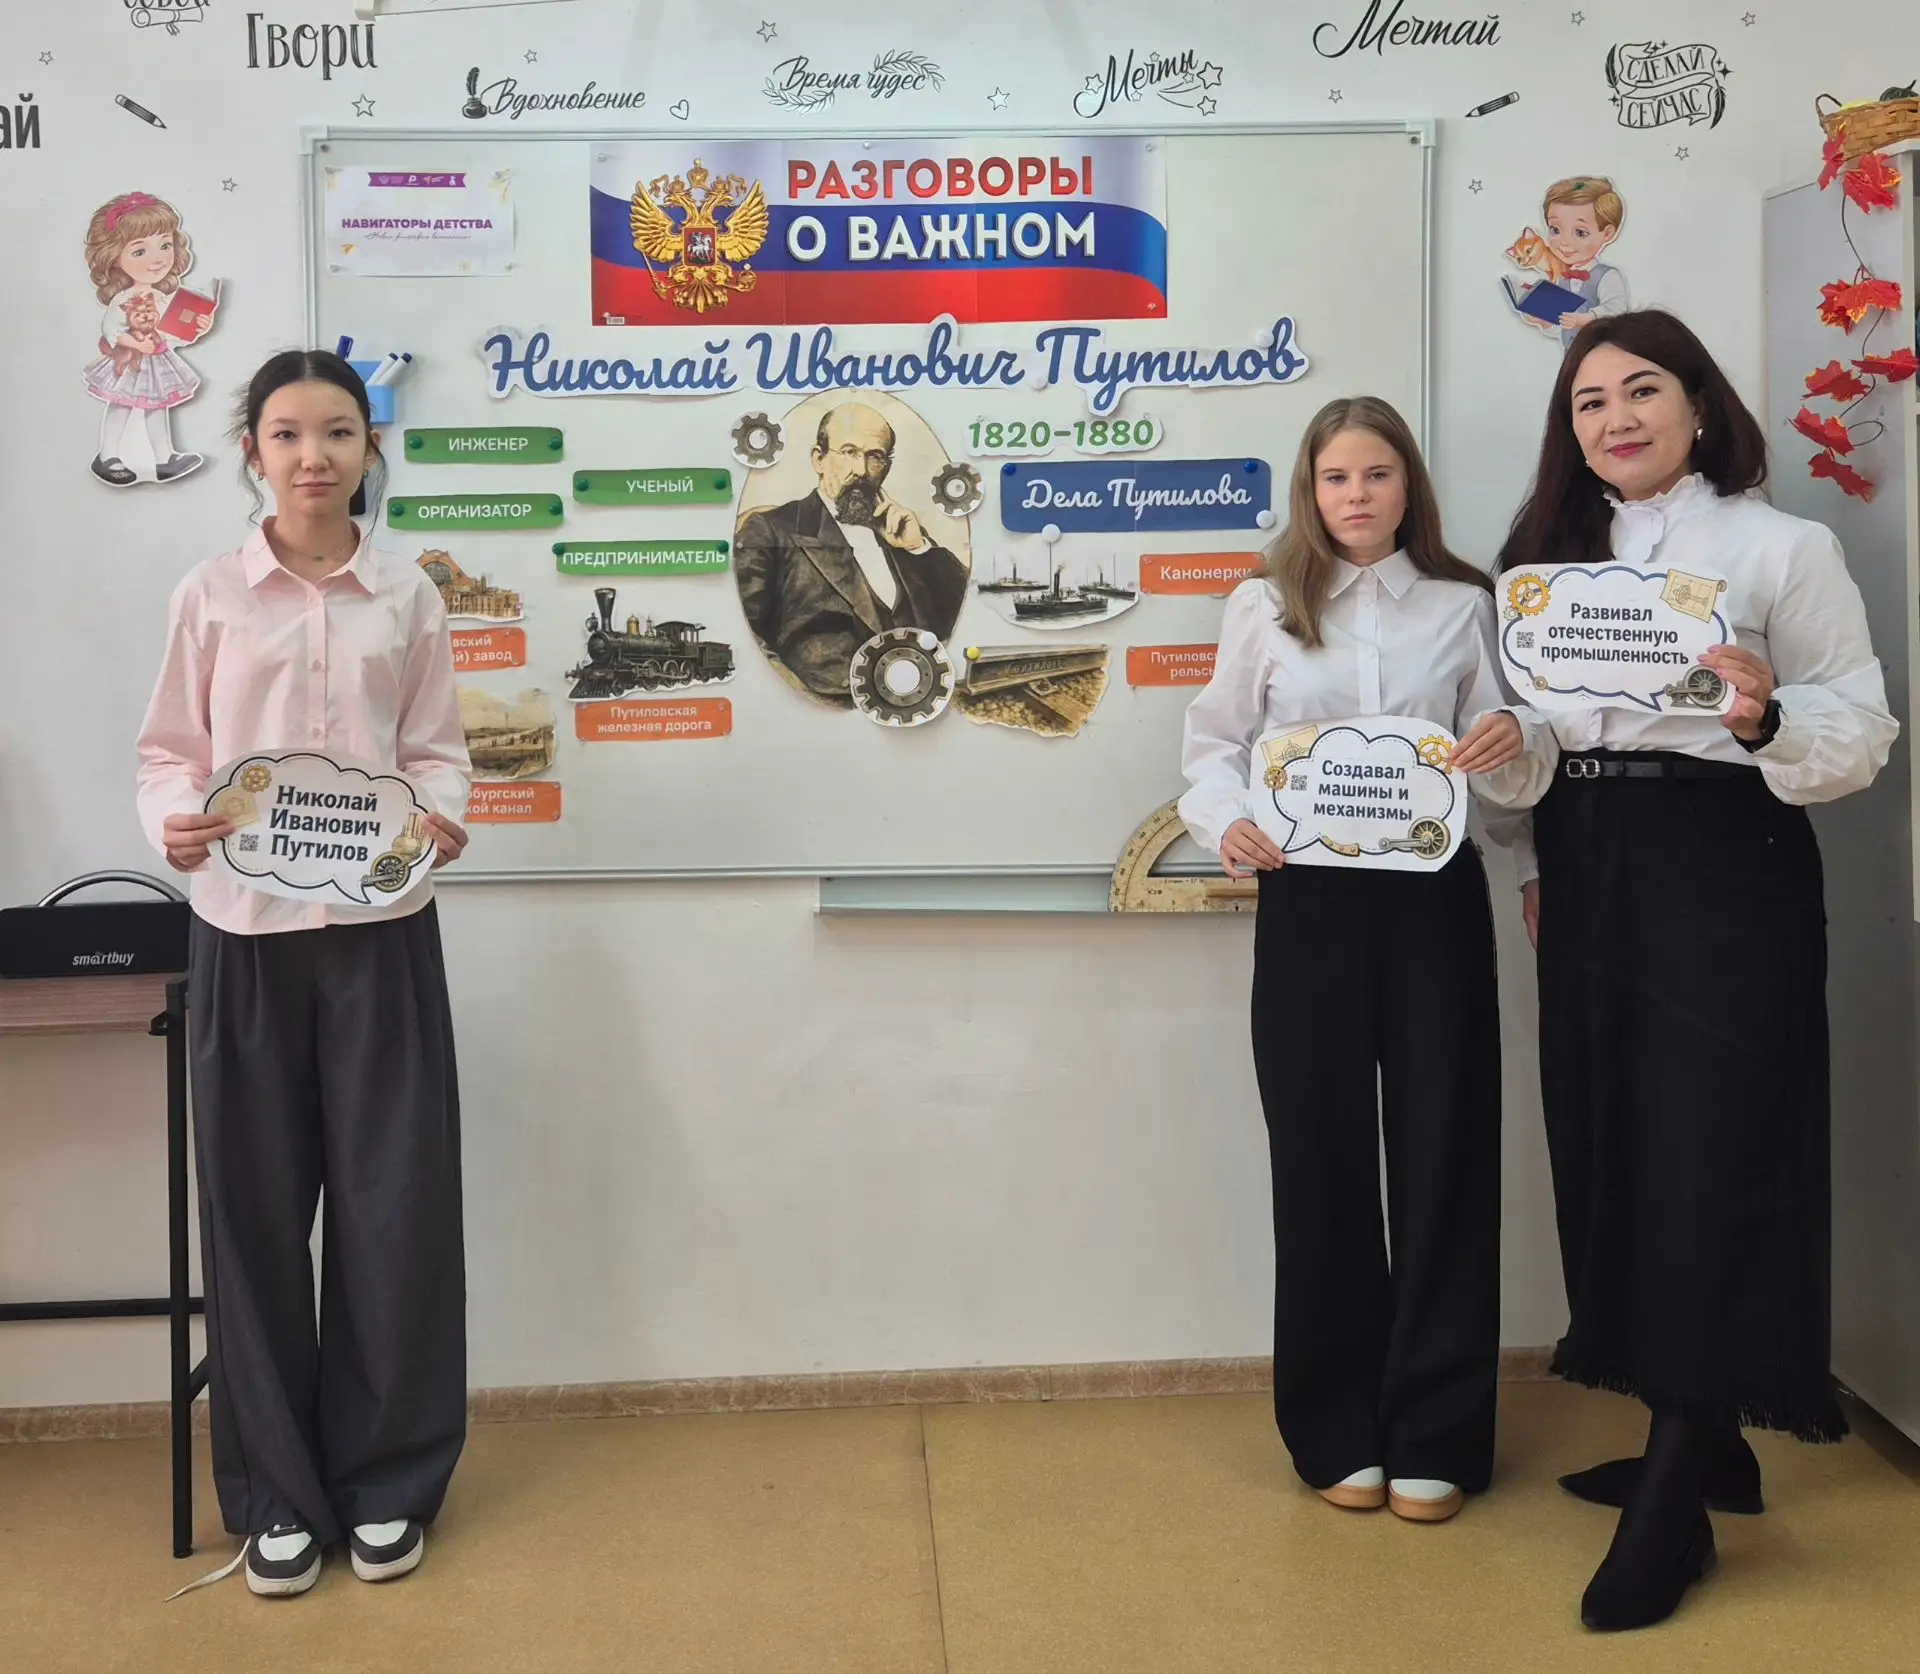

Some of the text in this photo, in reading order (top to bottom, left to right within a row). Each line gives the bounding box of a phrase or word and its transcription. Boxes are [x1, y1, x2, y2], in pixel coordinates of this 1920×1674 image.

[1313, 0, 1501, 58] Мечтай
[1627, 47, 1705, 85] СДЕЛАЙ
[773, 55, 926, 98] Время чудес
[1073, 49, 1199, 118] Мечты
[481, 77, 646, 120] Вдохновение
[1627, 87, 1702, 127] СЕЙЧАС
[787, 156, 1094, 200] РАЗГОВОРЫ
[342, 218, 493, 230] НАВИГАТОРЫ ДЕТСТВА
[787, 211, 1096, 263] О ВАЖНОМ
[484, 316, 1305, 412] Николай Иванович Путилов
[448, 437, 529, 452] ИНЖЕНЕР
[626, 476, 694, 494] УЧЕНЫЙ
[1022, 473, 1252, 521] Дела Путилова
[418, 503, 532, 519] ОРГАНИЗАТОР
[562, 550, 726, 568] ПРЕДПРИНИМАТЕЛЬ
[1570, 603, 1653, 622] Развивал
[1548, 626, 1678, 646] отечественную
[473, 650, 513, 662] завод
[1541, 646, 1689, 665] промышленность
[610, 706, 698, 720] Путиловская
[598, 720, 712, 734] железная дорога
[1321, 760, 1405, 780] Создавал
[276, 785, 378, 812] Николай
[1318, 783, 1409, 800] машины и
[492, 803, 532, 814] канал
[1313, 802, 1412, 821] механизмы
[269, 808, 381, 837] Иванович
[270, 834, 369, 862] Путилов
[72, 951, 134, 967] smartbuy
